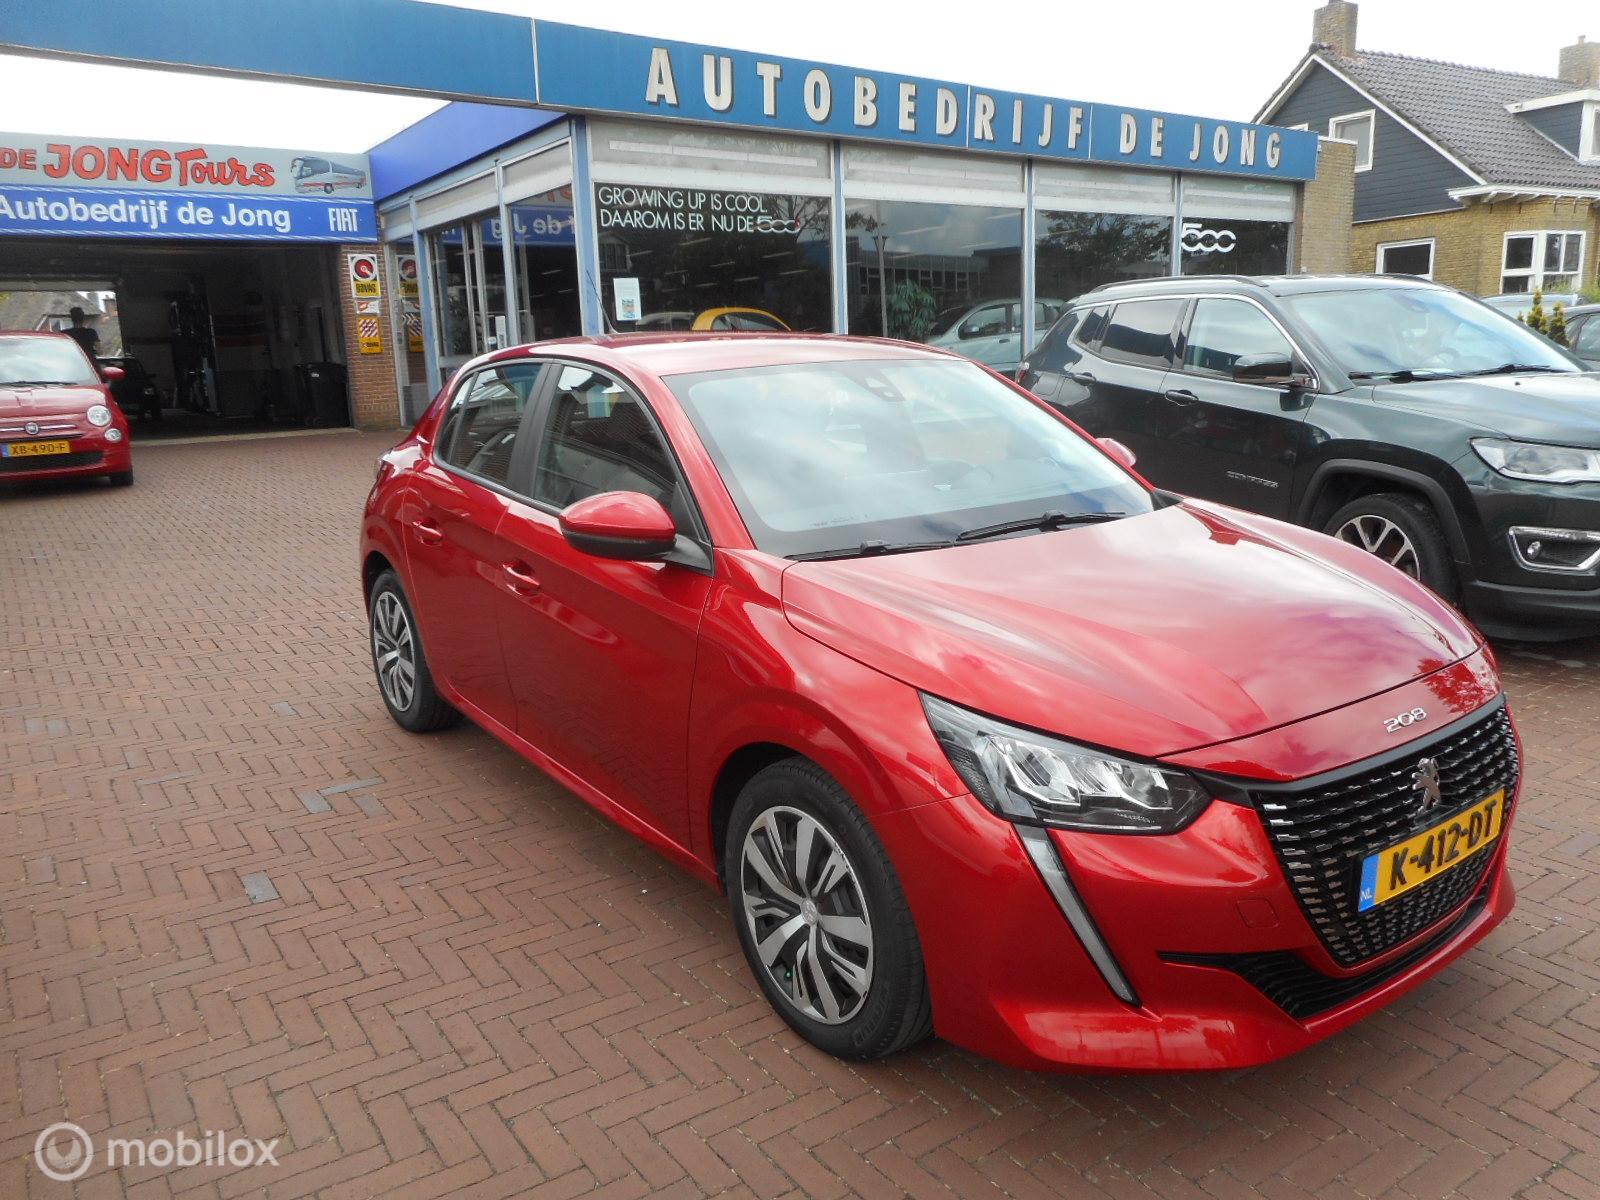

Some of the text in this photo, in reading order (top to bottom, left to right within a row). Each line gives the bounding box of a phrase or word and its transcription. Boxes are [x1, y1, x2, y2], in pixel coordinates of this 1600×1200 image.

[645, 47, 1281, 168] AUTOBEDRIJF DE JONG
[0, 144, 276, 187] DE JONG Tours
[0, 195, 292, 233] Autobedrijf de Jong
[598, 186, 684, 208] GROWING
[687, 191, 706, 210] UP
[710, 193, 722, 211] IS
[328, 207, 359, 232] FIAT
[600, 208, 671, 229] DAAROM
[673, 212, 686, 230] IS
[689, 213, 705, 231] ER
[711, 215, 734, 232] NU
[738, 217, 754, 233] DE
[1181, 222, 1237, 253] 500
[1384, 707, 1427, 733] 208
[1389, 801, 1497, 890] K-412-DT
